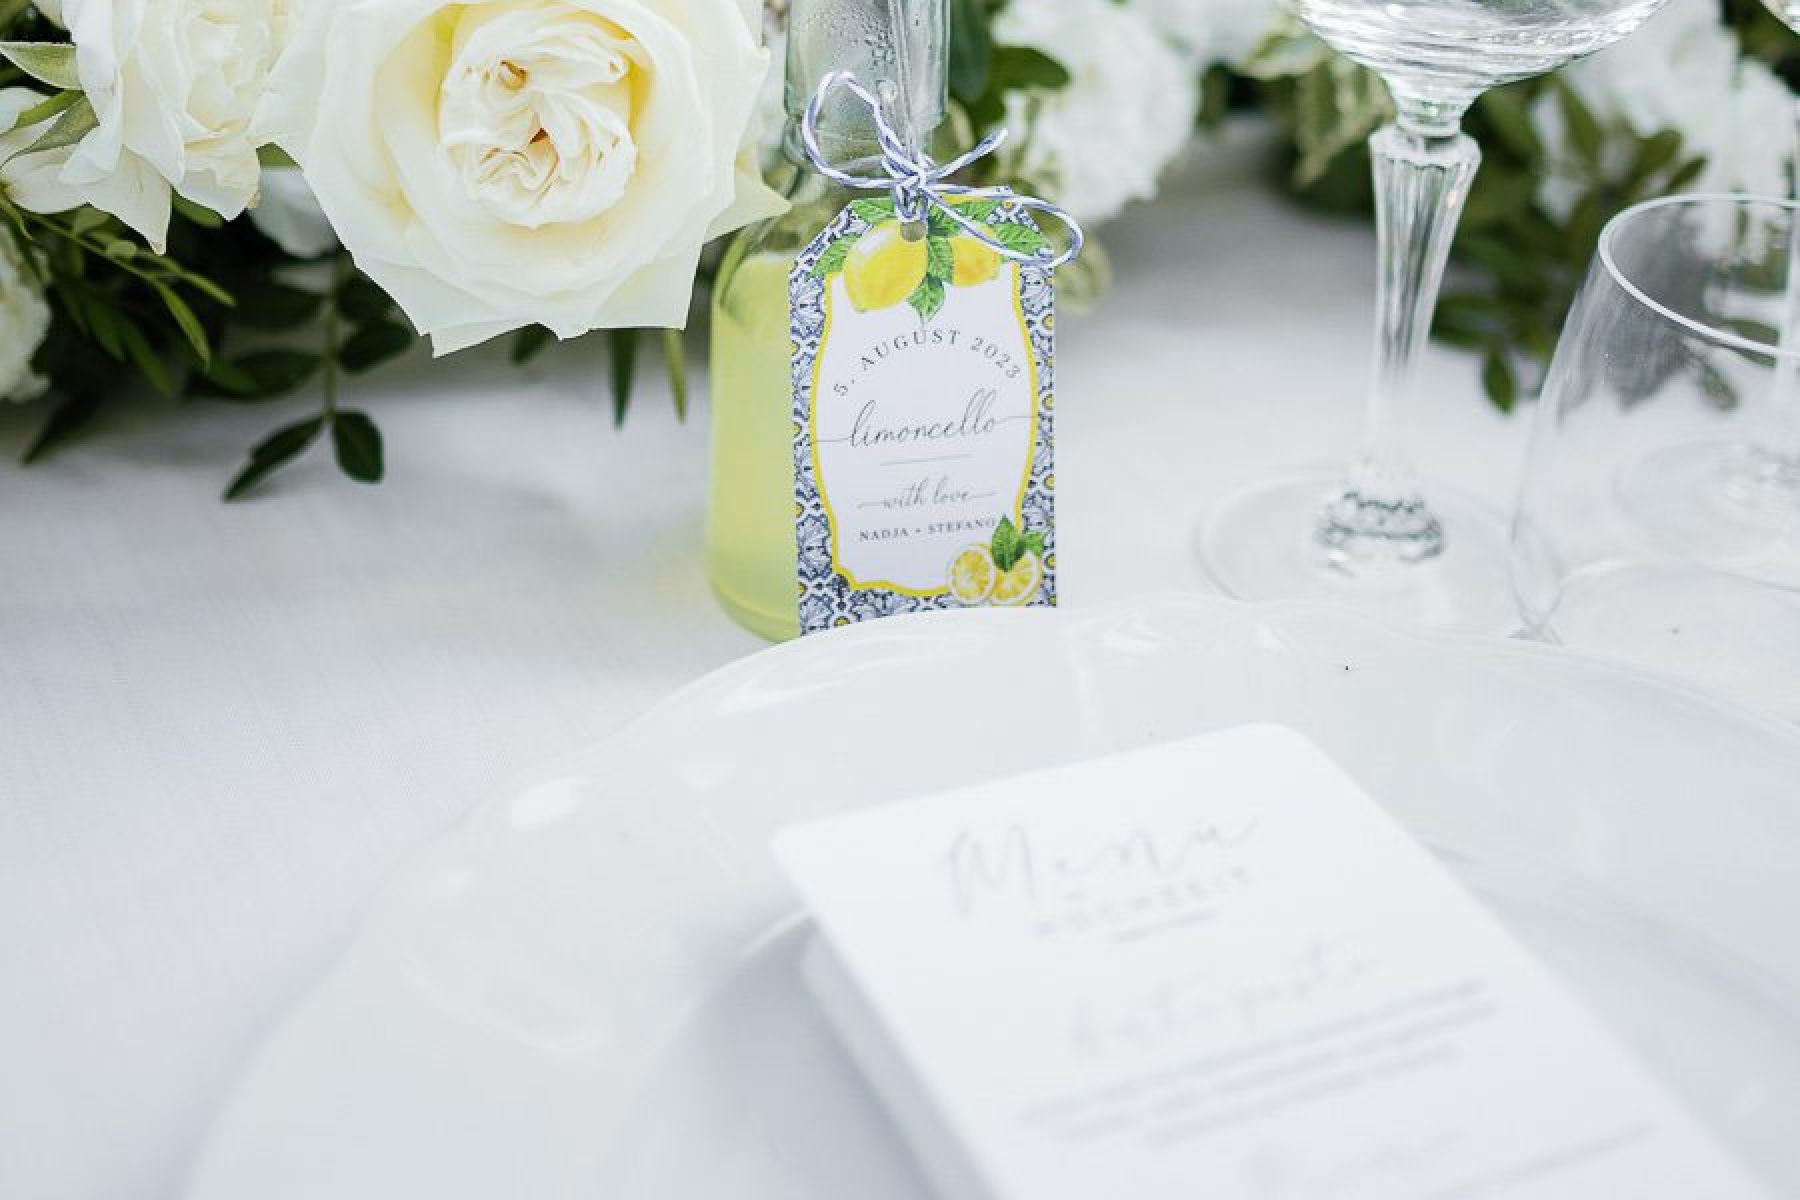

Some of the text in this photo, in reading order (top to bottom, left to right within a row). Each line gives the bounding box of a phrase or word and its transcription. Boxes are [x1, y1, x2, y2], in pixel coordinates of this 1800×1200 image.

[861, 329, 961, 371] AUGUST
[971, 336, 1021, 379] 2023
[815, 387, 1036, 447] limoncello
[858, 475, 995, 509] with love
[859, 527, 909, 542] NADJA
[927, 518, 997, 535] STEFANO
